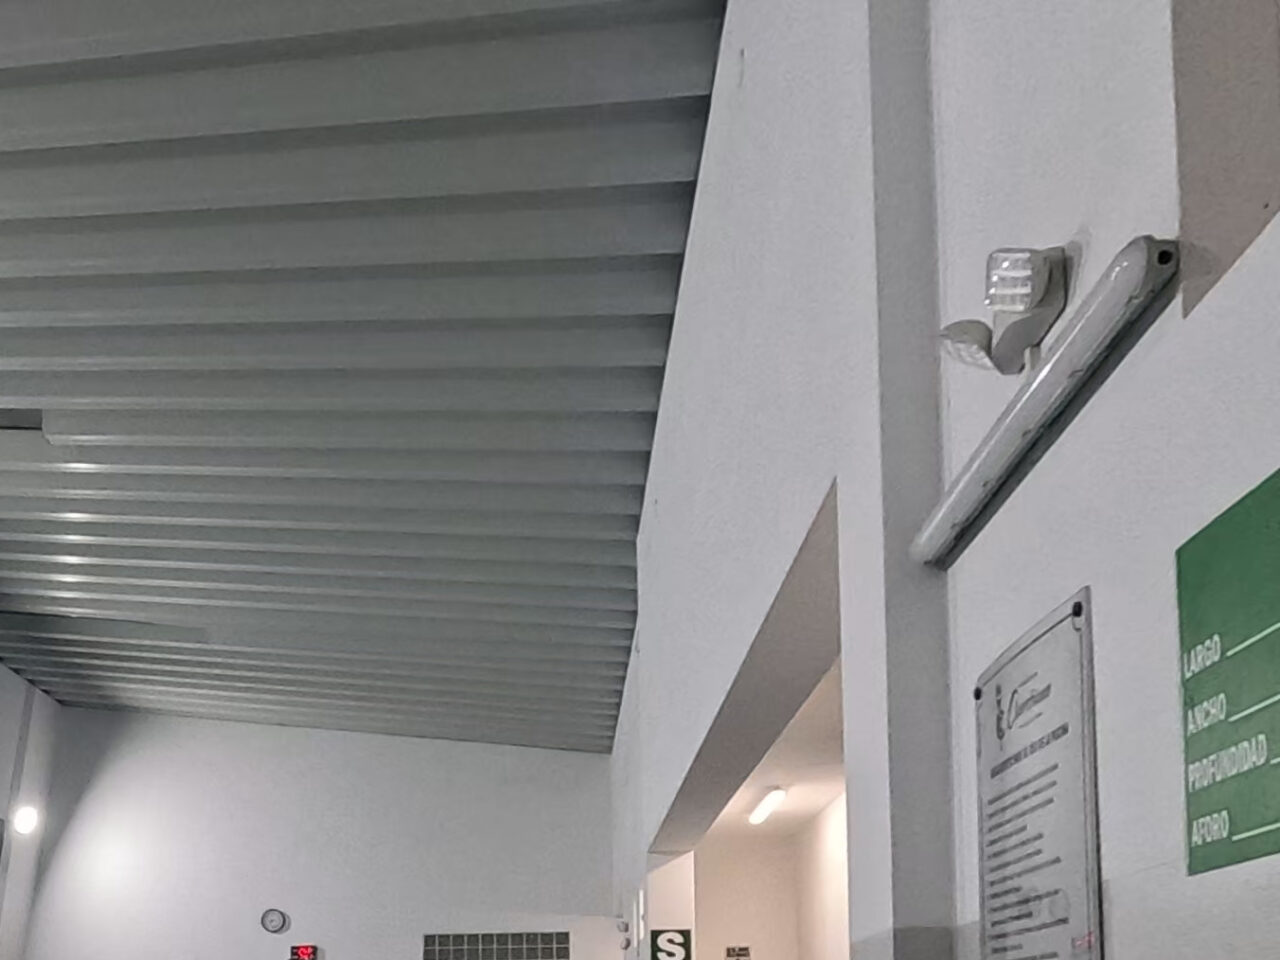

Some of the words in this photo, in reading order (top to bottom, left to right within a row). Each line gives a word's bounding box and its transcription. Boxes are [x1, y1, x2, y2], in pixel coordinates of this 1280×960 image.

[1183, 633, 1221, 679] LARGO
[1187, 692, 1226, 738] ANCHO
[1188, 733, 1267, 793] PROFUNDIDAD
[1191, 809, 1229, 847] AFORO
